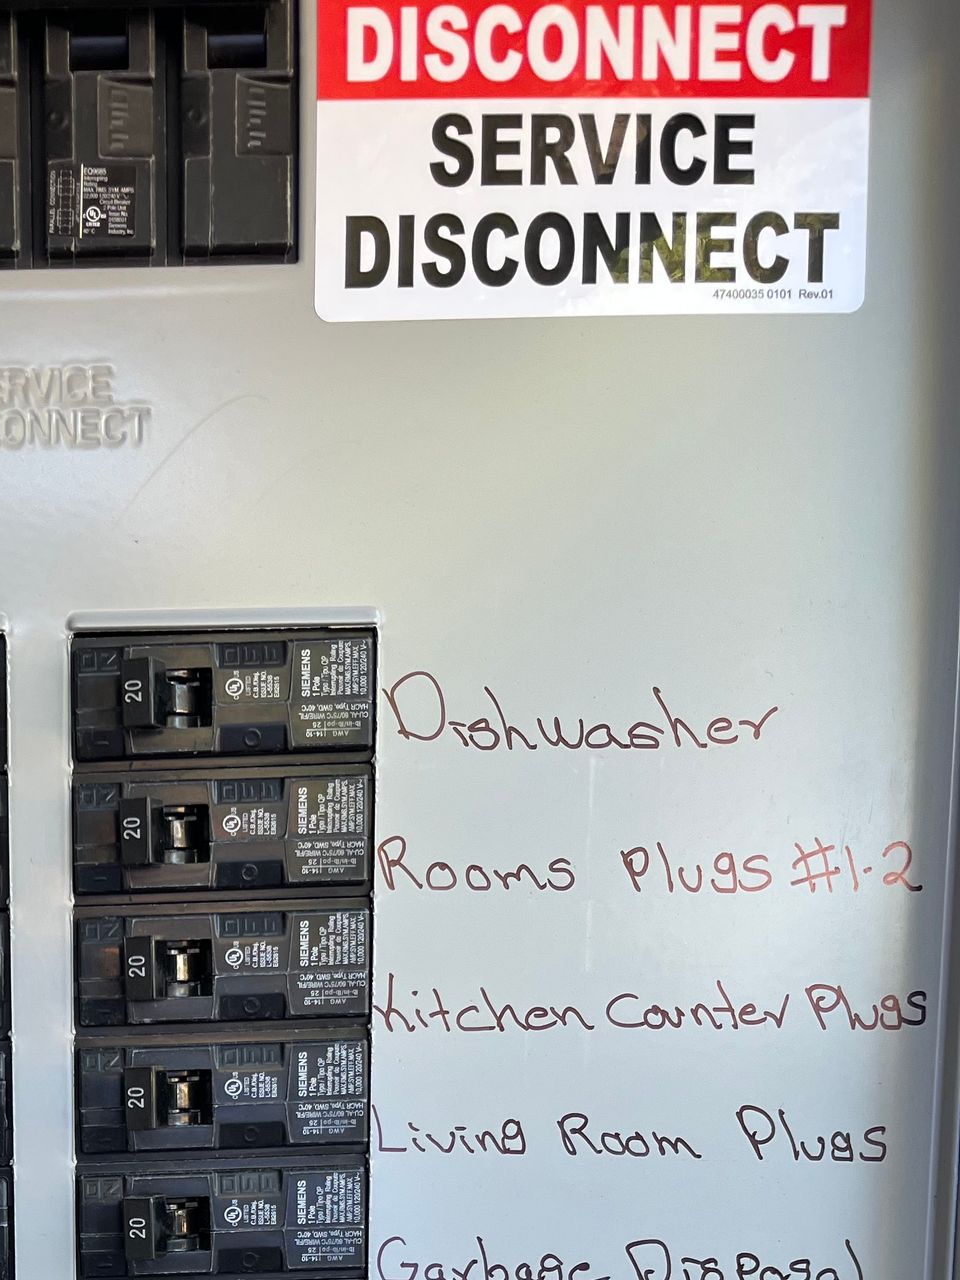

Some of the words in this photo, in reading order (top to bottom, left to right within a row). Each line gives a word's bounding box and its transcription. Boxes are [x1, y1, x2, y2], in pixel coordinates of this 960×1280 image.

[346, 4, 847, 82] DISCONNECT
[429, 112, 756, 187] SERVICE
[343, 211, 840, 289] DISCONNECT
[713, 288, 764, 300] 47400035
[767, 288, 792, 299] 0101
[798, 288, 834, 299] Rev.01
[124, 678, 143, 704] 20
[300, 648, 311, 698] SIEMENS
[382, 671, 779, 751] Dishwasher
[123, 816, 142, 841] 20
[297, 786, 308, 835] SIEMENS
[376, 835, 577, 892] Rooms
[620, 841, 774, 894] Plugs
[128, 954, 146, 979] 20
[299, 919, 310, 968] SIEMENS
[370, 972, 595, 1034] Kitchen
[604, 980, 790, 1031] Counter
[803, 983, 928, 1031] Plugs
[127, 1085, 146, 1110] 20
[297, 1050, 308, 1098] SIEMENS
[370, 1102, 528, 1155] Living
[556, 1112, 703, 1160] Room
[735, 1104, 888, 1163] Plugs
[296, 1179, 307, 1226] SIEMENS
[129, 1216, 147, 1240] 20
